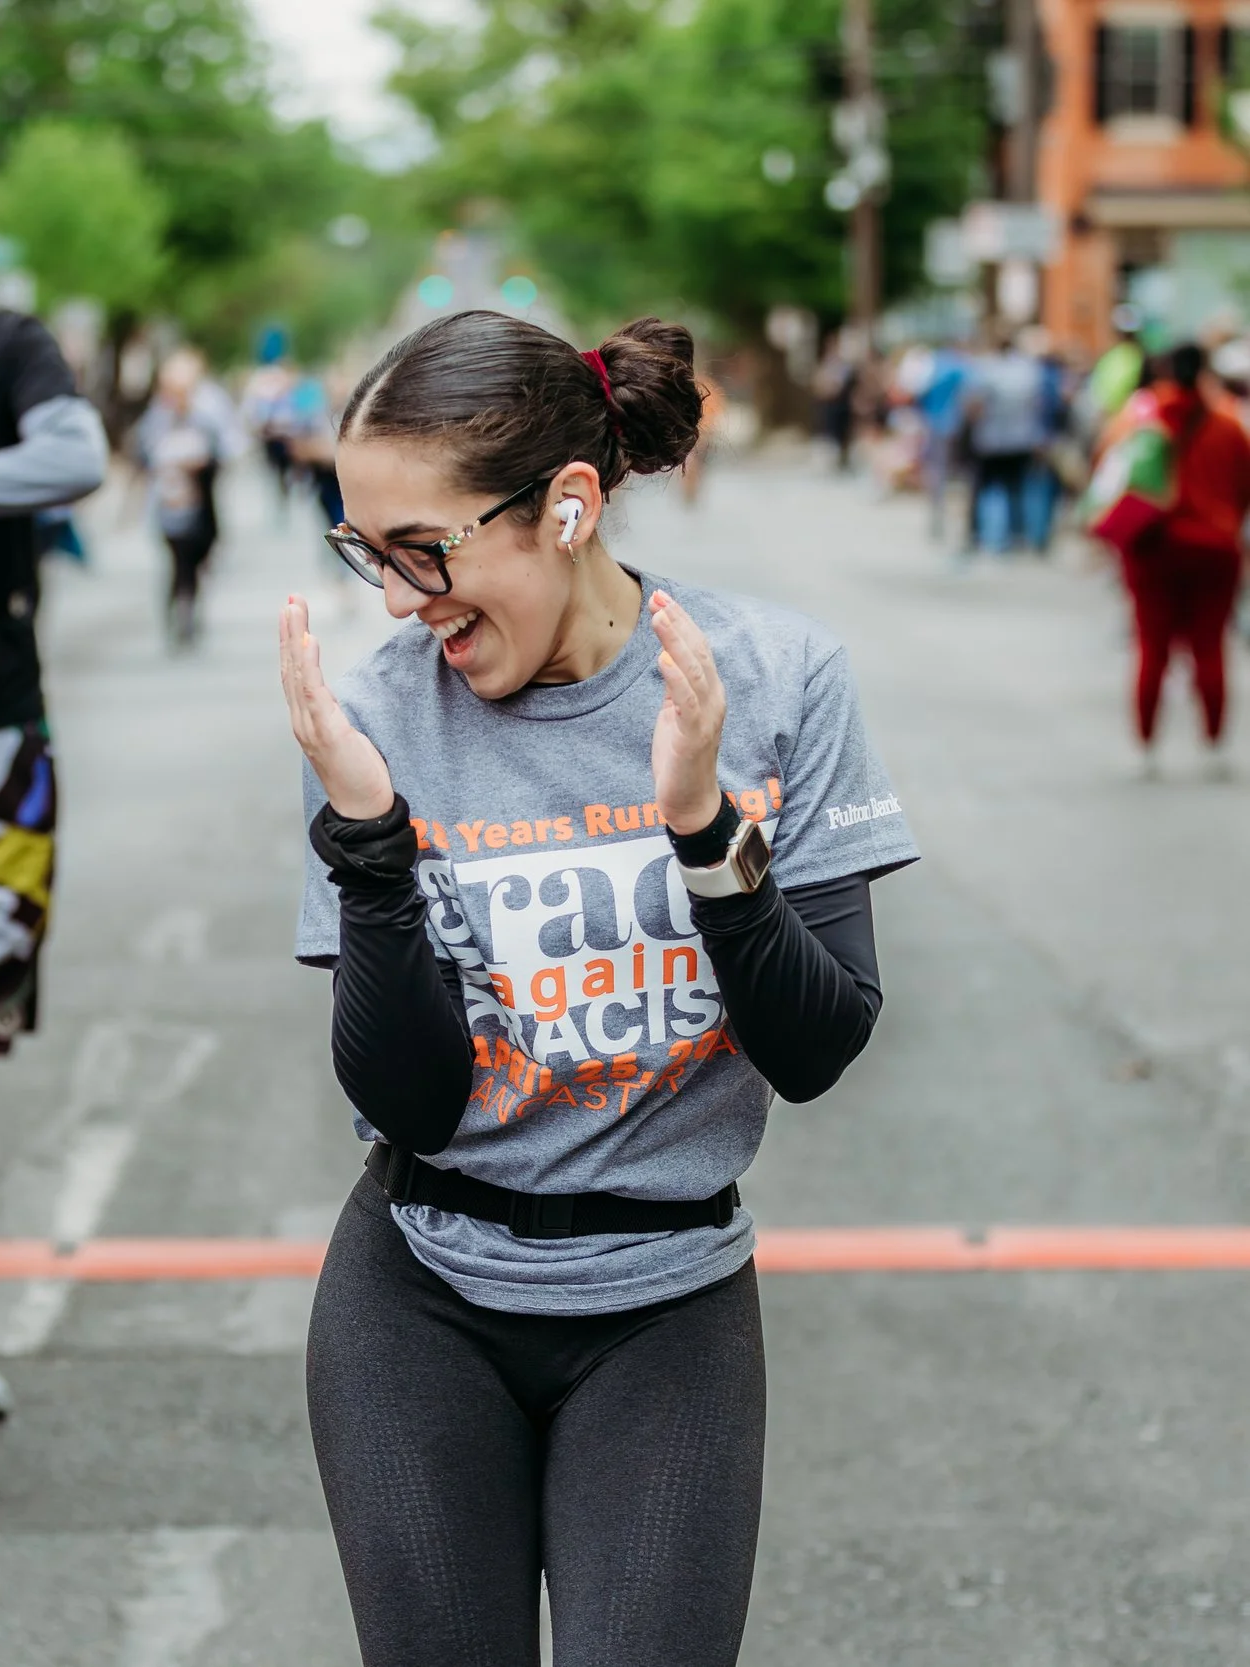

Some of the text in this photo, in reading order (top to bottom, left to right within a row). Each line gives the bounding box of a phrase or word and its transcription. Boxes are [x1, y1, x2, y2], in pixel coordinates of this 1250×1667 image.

[455, 816, 574, 853] Years
[584, 777, 781, 838] Rung!
[826, 793, 902, 830] Fulton Bank
[488, 943, 717, 1022] again
[500, 985, 722, 1066] RACIS
